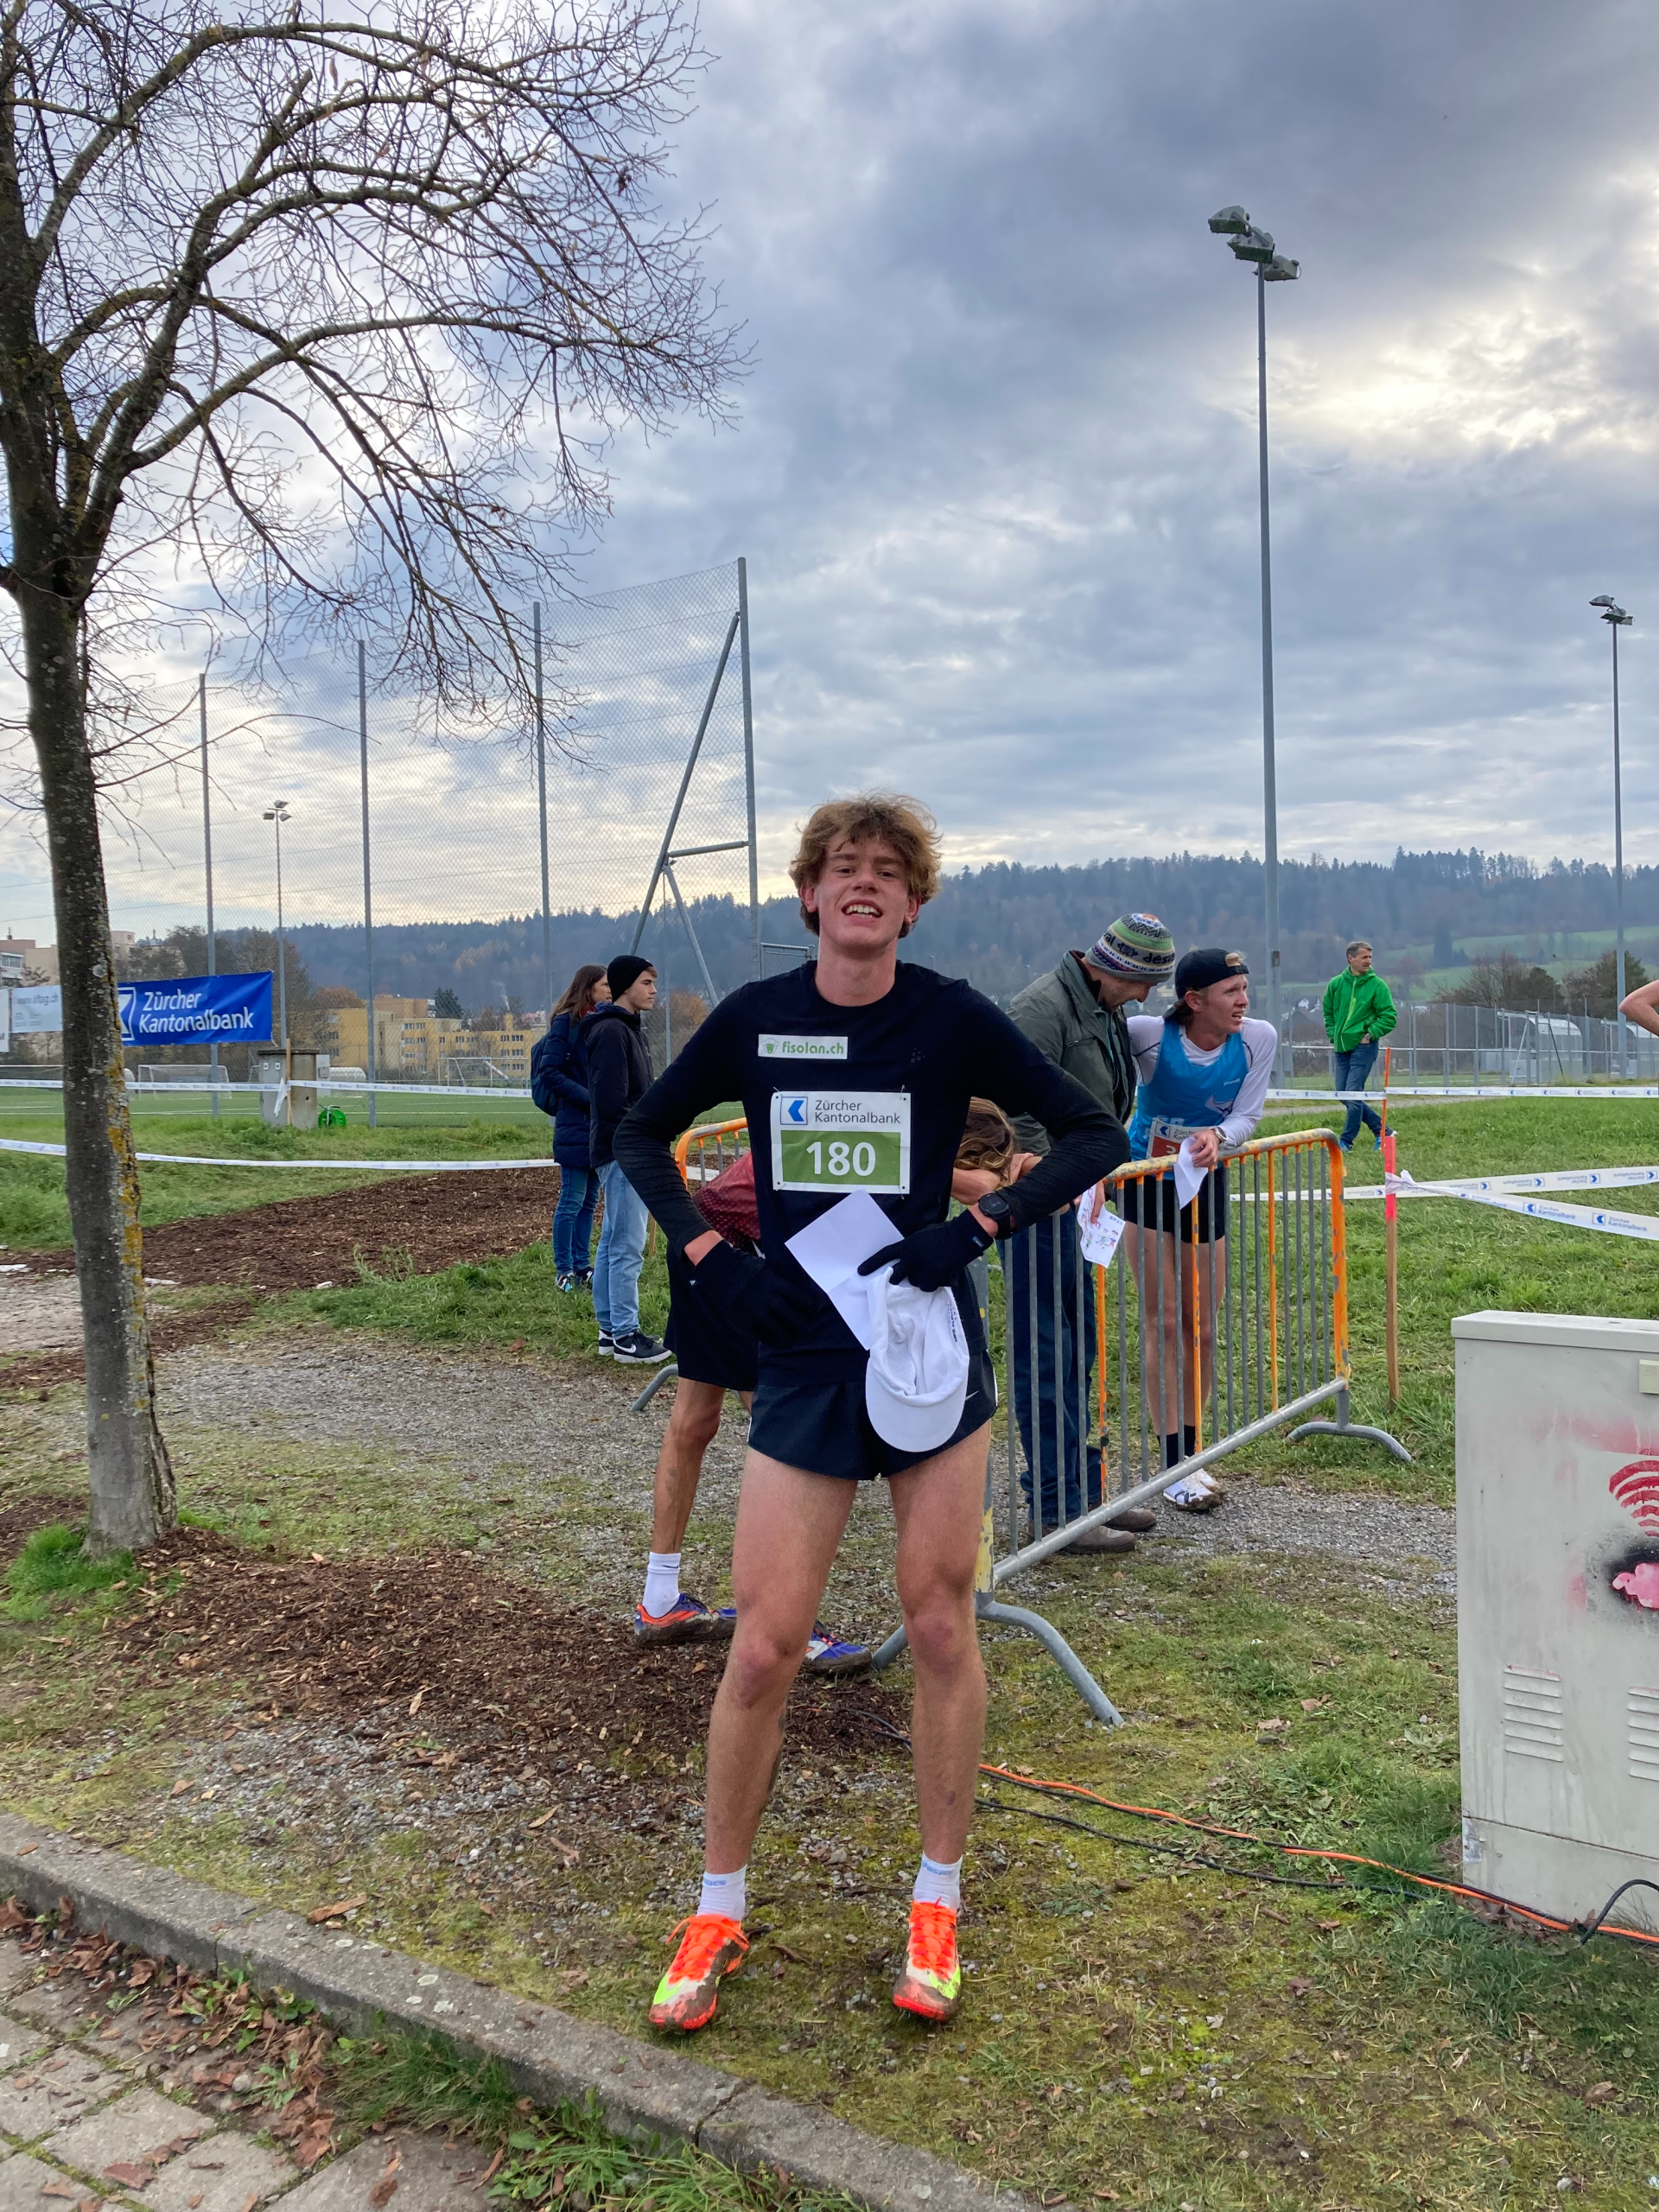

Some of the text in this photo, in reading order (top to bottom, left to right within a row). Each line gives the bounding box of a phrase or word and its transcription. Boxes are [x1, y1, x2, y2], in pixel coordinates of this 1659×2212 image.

[143, 988, 202, 1012] Zürcher
[138, 1007, 255, 1034] Kantonalbank
[782, 1041, 844, 1055] fisolan.ch
[815, 1099, 862, 1111] Zürcher
[815, 1111, 901, 1124] Kantonalbank
[806, 1141, 876, 1177] 180
[1538, 1210, 1576, 1220] Kantonalbank
[1608, 1221, 1648, 1231] Kantonalbank
